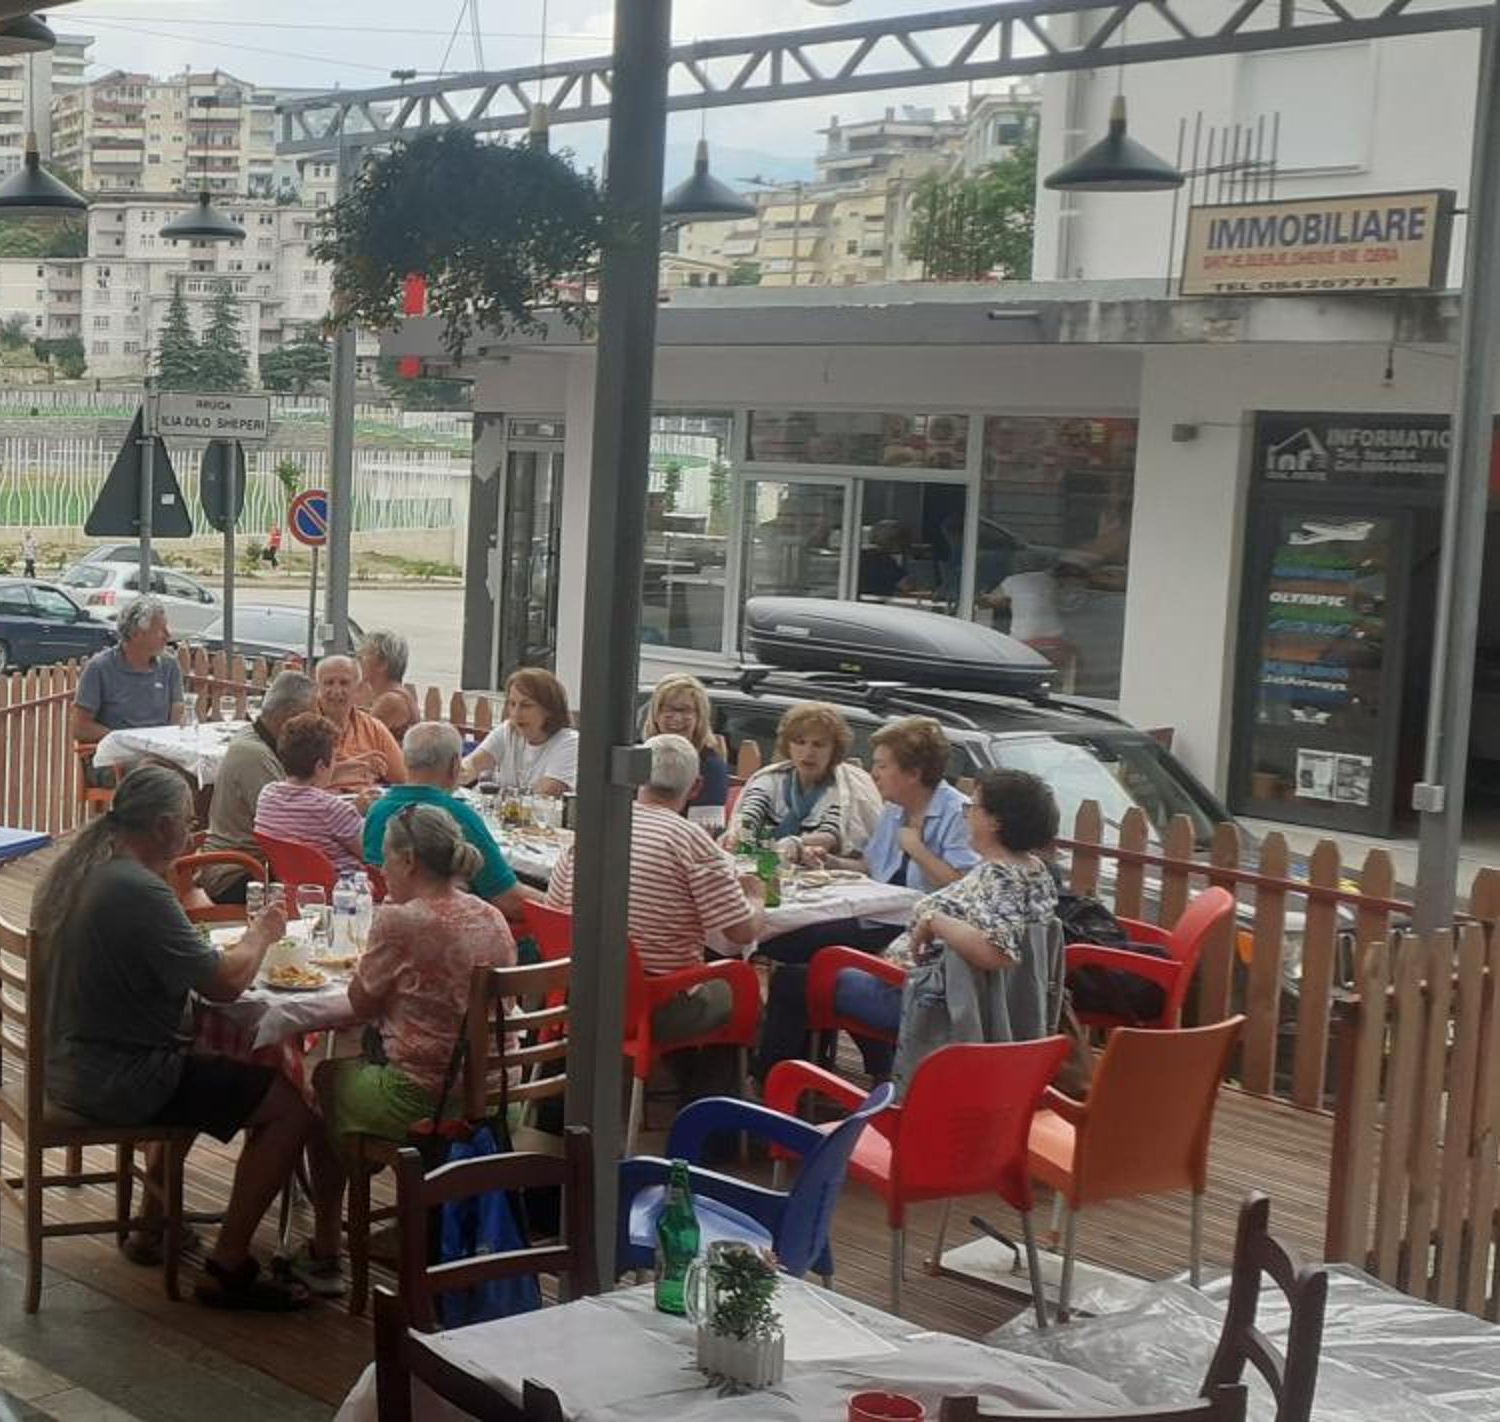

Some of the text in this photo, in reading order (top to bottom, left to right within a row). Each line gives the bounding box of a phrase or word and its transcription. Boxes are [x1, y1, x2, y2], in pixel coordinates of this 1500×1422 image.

[1207, 206, 1428, 250] IMMOBILIARE
[1213, 282, 1252, 292] TEL
[184, 415, 211, 429] DILO
[217, 417, 266, 432] SHEPERI
[1269, 591, 1348, 607] OLYMPIC
